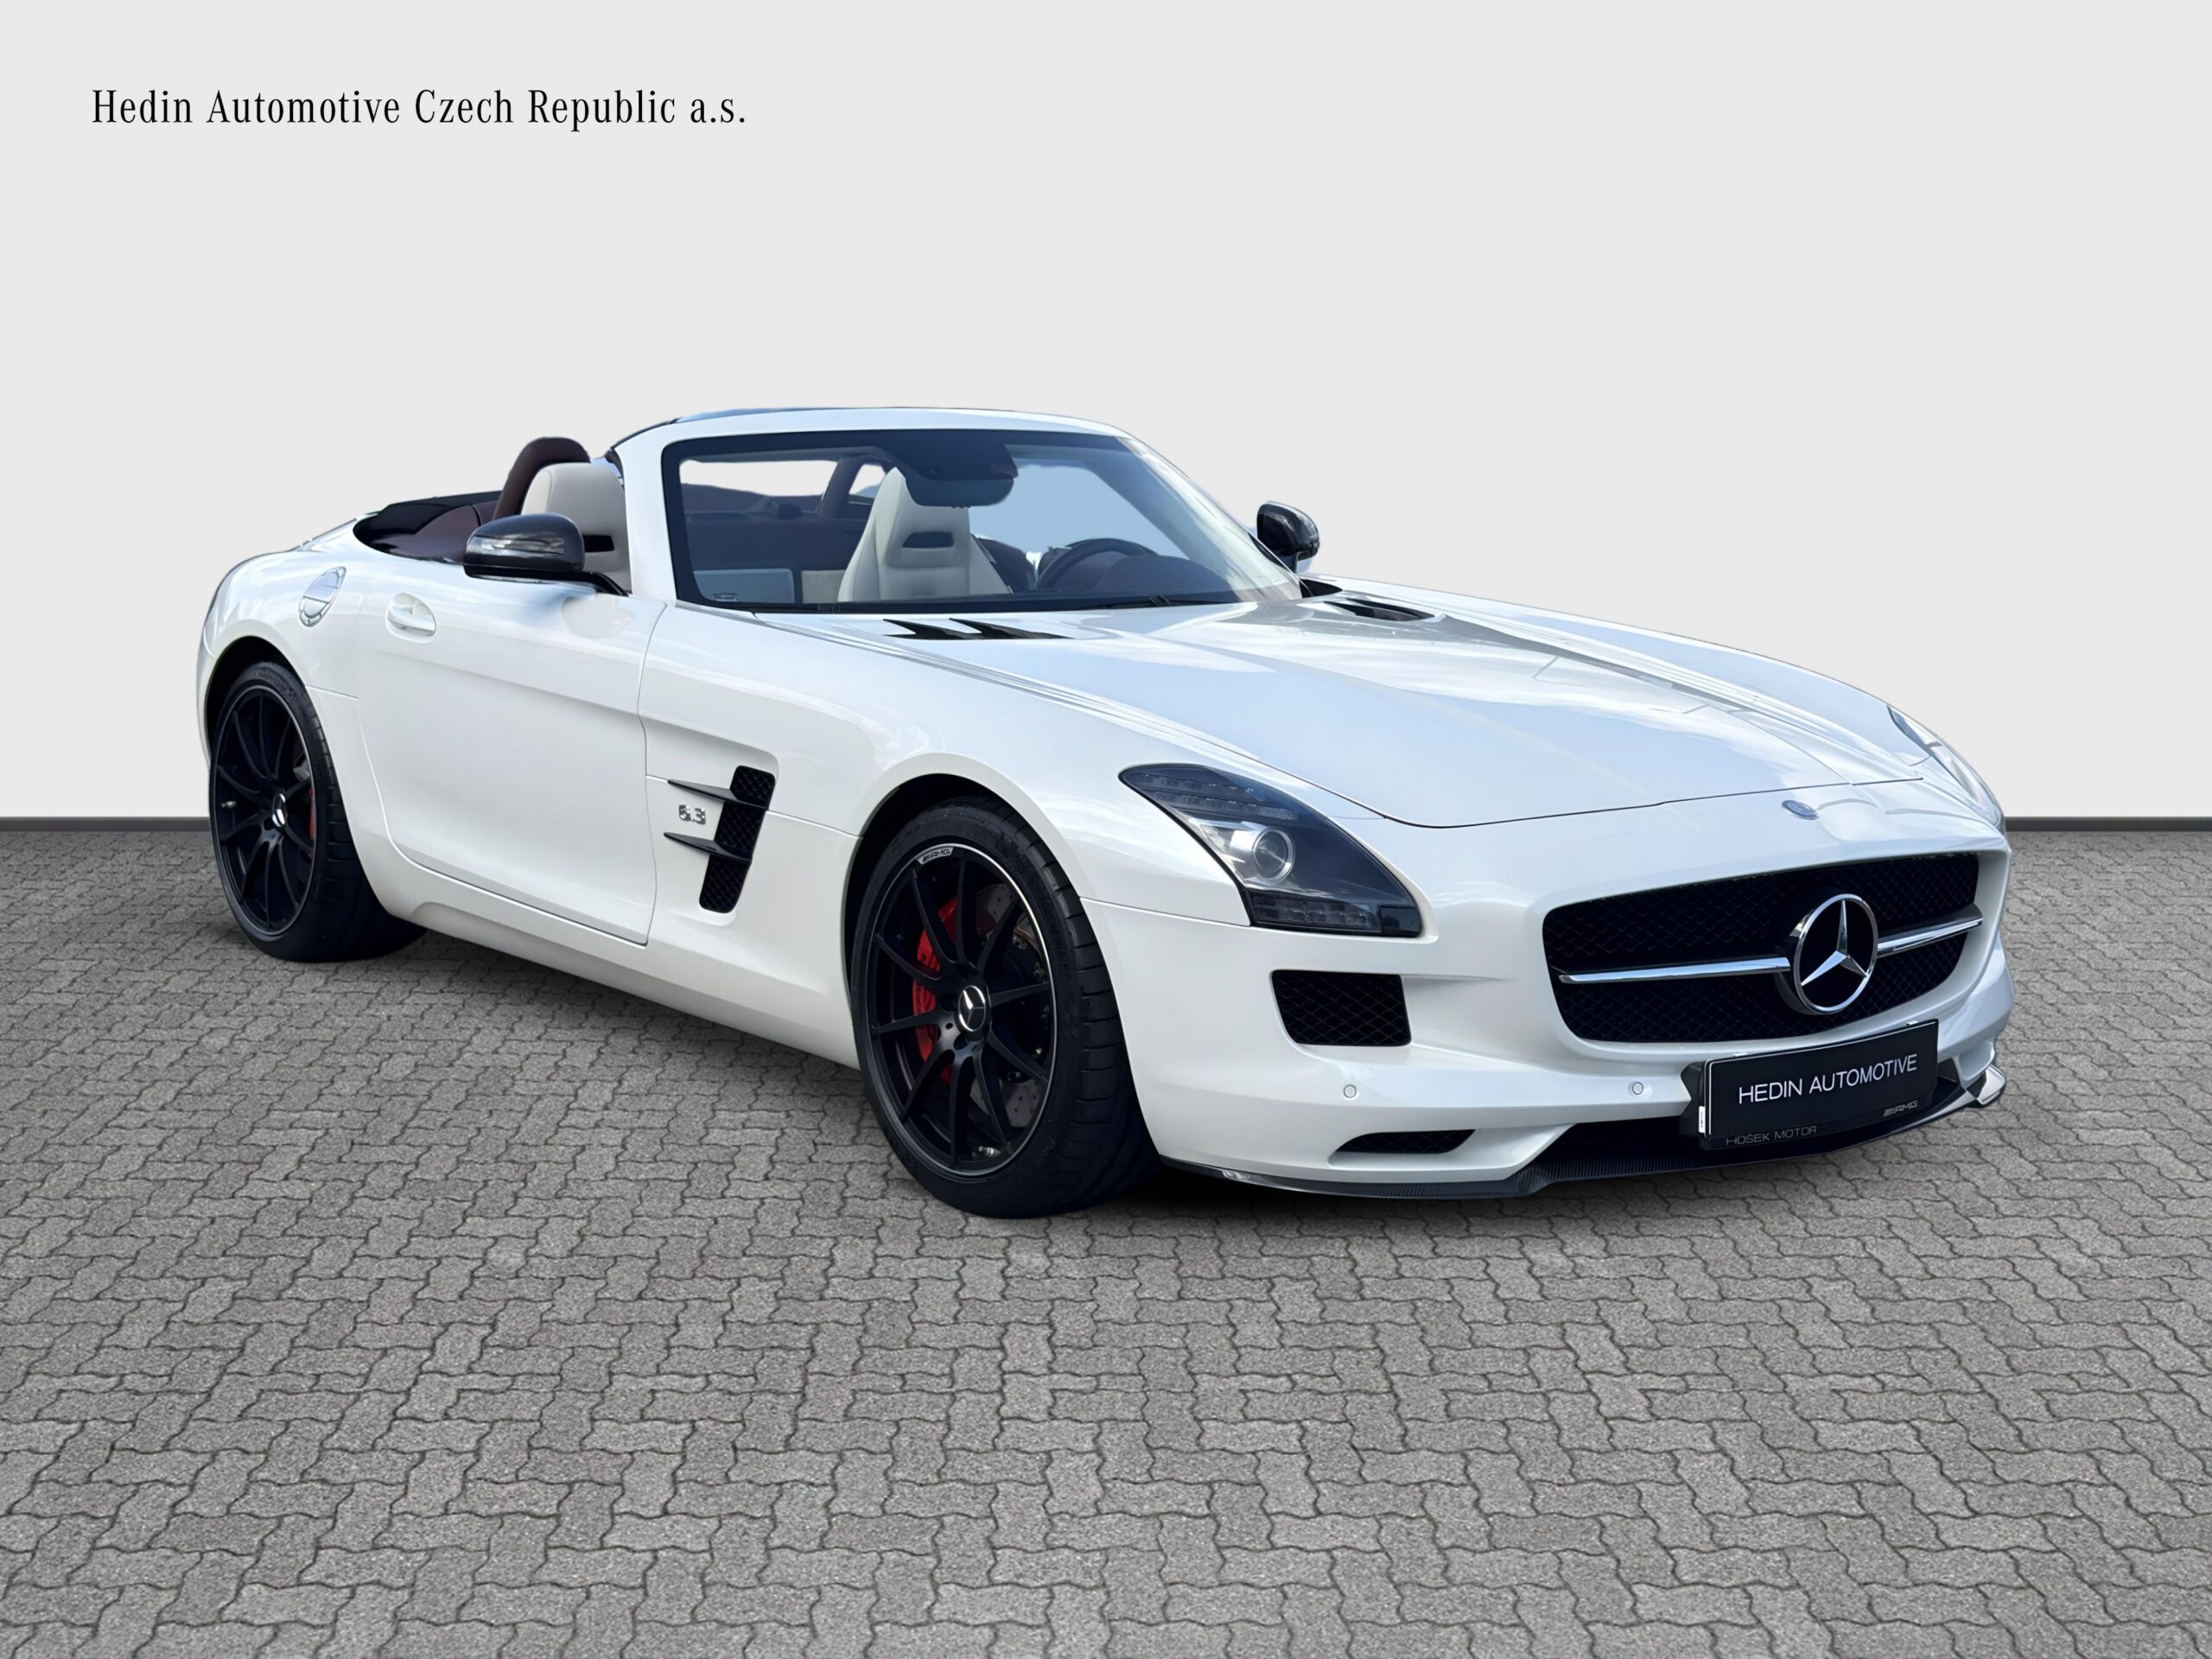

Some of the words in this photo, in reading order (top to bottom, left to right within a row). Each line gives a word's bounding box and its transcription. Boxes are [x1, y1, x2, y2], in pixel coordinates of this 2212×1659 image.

[678, 804, 707, 825] 6.3
[1738, 1078, 1803, 1104] HEDIN
[1808, 1053, 1918, 1094] AUTOMOTIVE
[1726, 1132, 1770, 1146] HOSEK
[1774, 1125, 1817, 1140] MOTOR
